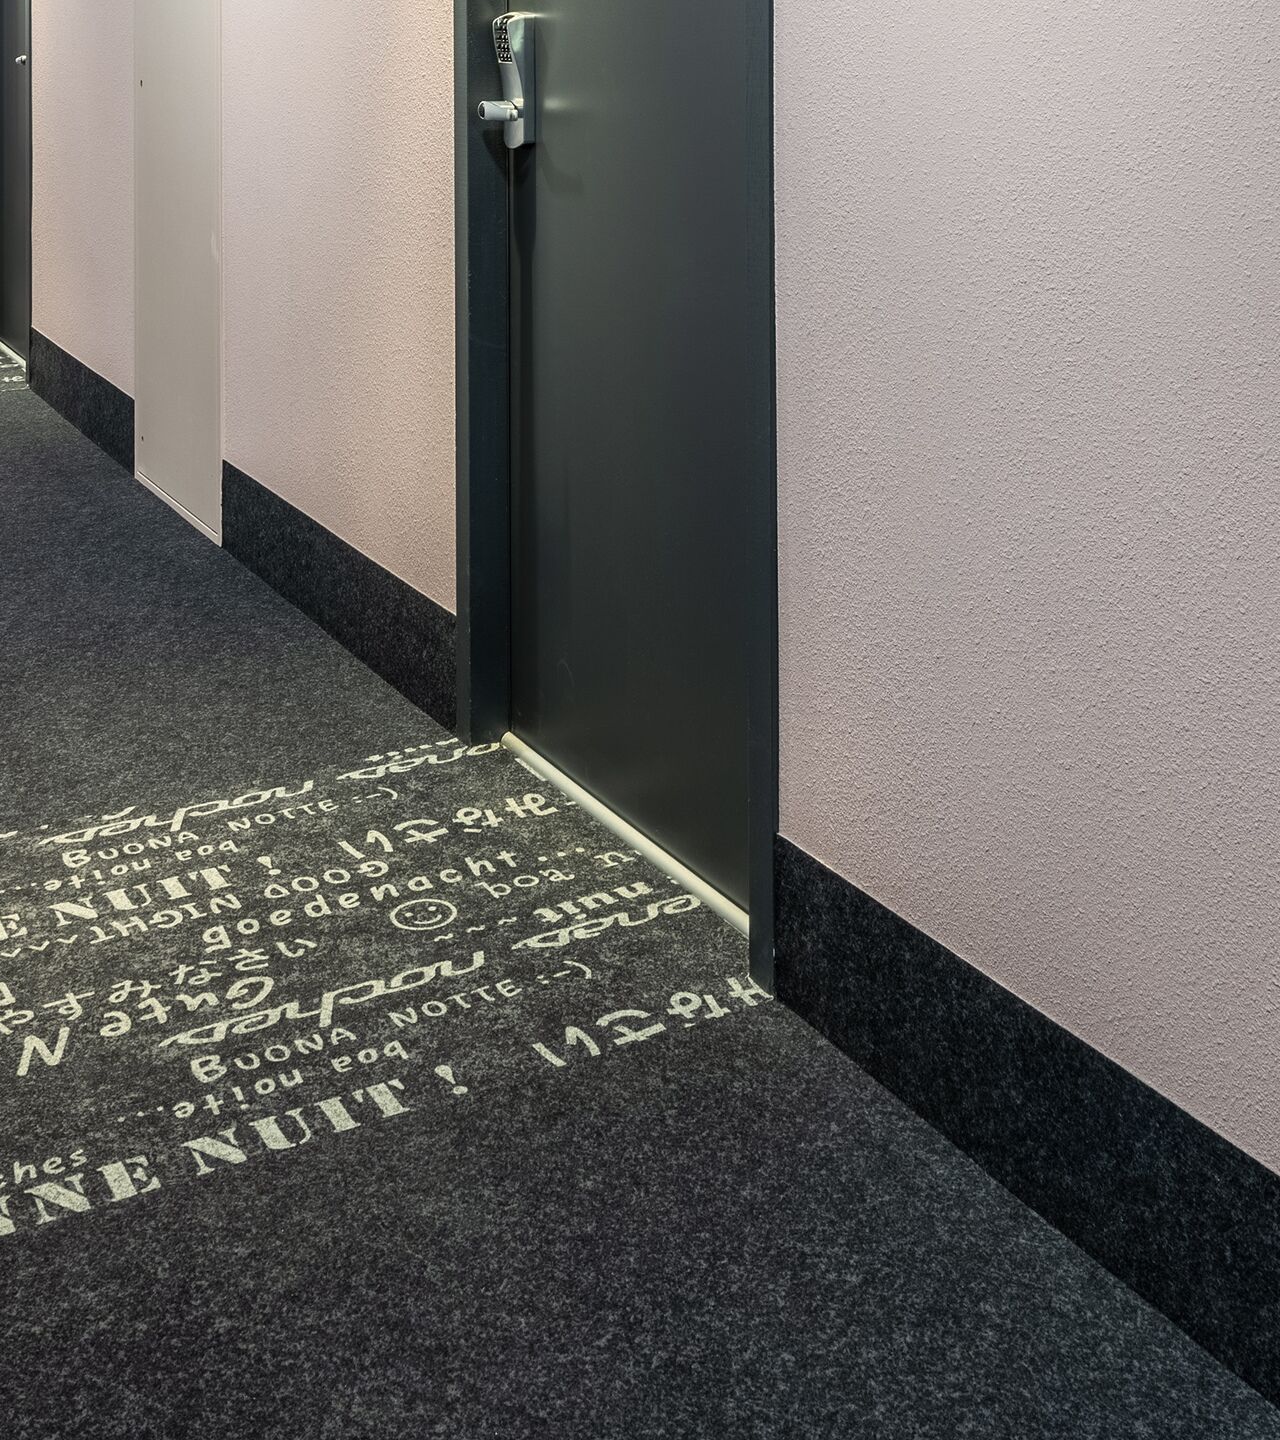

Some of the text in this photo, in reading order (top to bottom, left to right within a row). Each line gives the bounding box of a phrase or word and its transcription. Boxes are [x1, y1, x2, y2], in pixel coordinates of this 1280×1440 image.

[338, 793, 576, 859] みなさい
[50, 865, 229, 926] NUIT
[264, 860, 388, 899] GOOD
[100, 977, 274, 1037] Gute
[331, 1040, 413, 1072] boa
[182, 1079, 409, 1175] NUIT
